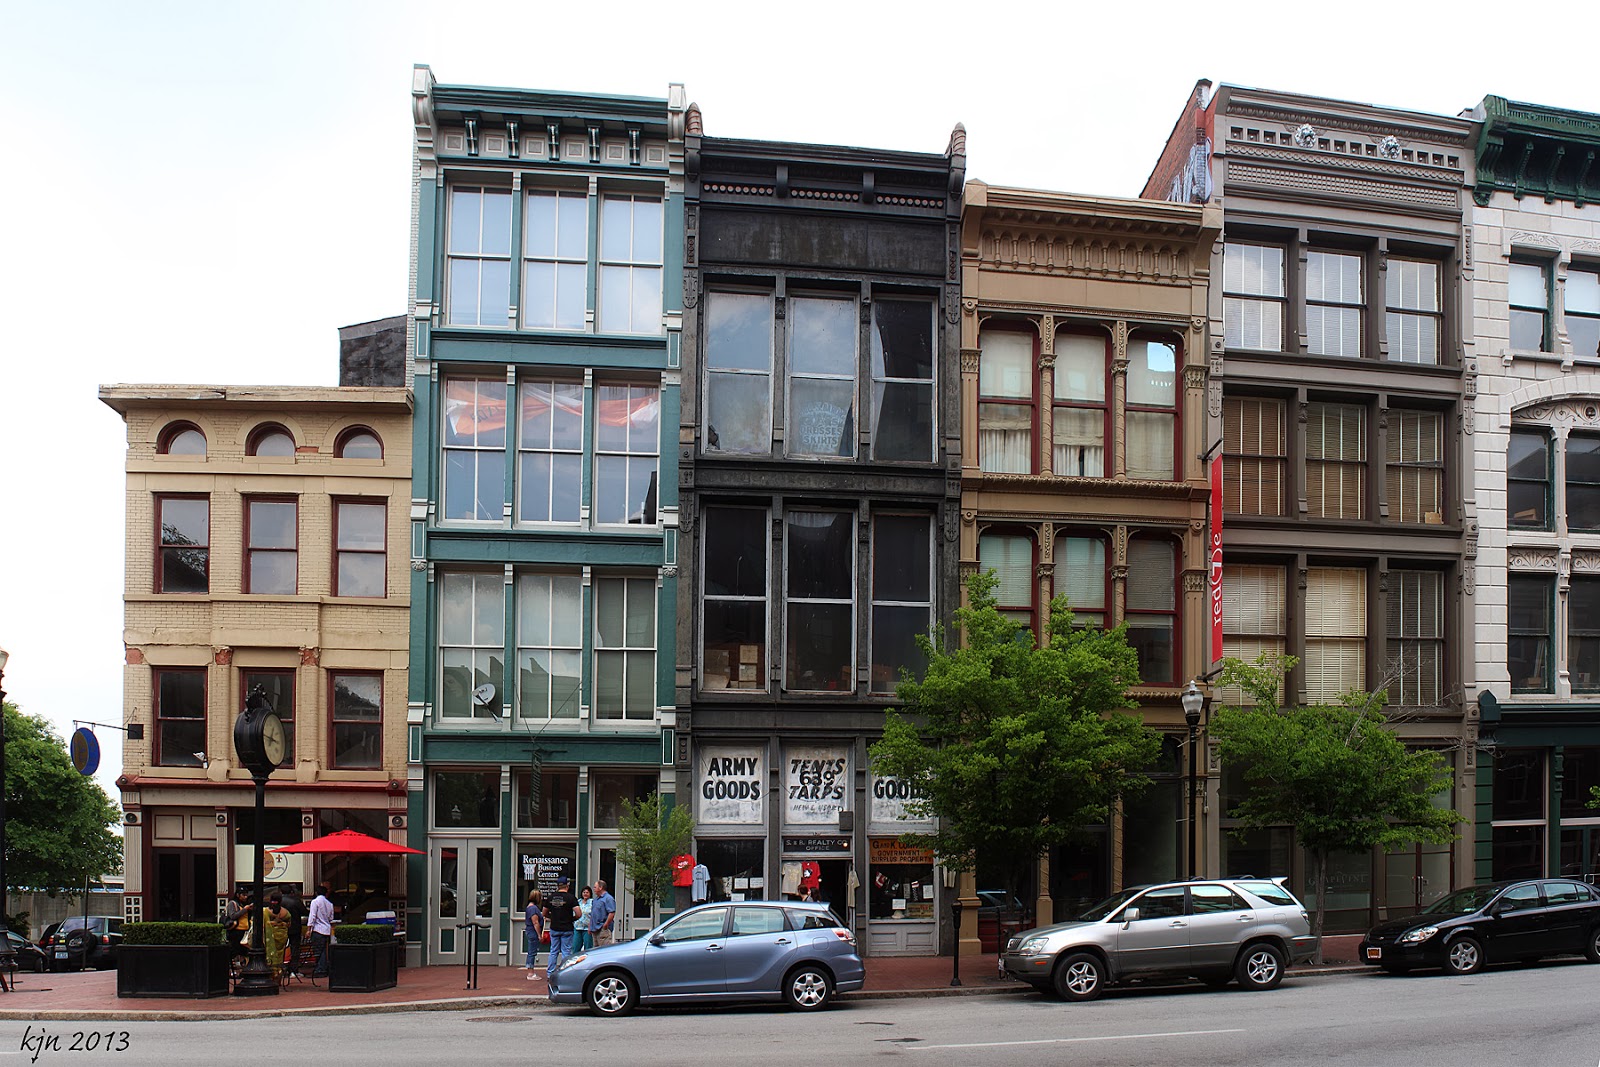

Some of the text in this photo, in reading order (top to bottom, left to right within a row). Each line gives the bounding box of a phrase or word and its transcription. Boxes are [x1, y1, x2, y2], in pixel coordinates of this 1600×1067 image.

[803, 435, 839, 445] SKIRTS
[707, 757, 758, 776] ARMY
[790, 758, 846, 775] TENTS
[702, 780, 761, 801] GOODS
[789, 785, 846, 800] TARPS
[873, 779, 931, 800] GOOD
[522, 854, 569, 864] Renaissance
[537, 863, 563, 871] Business
